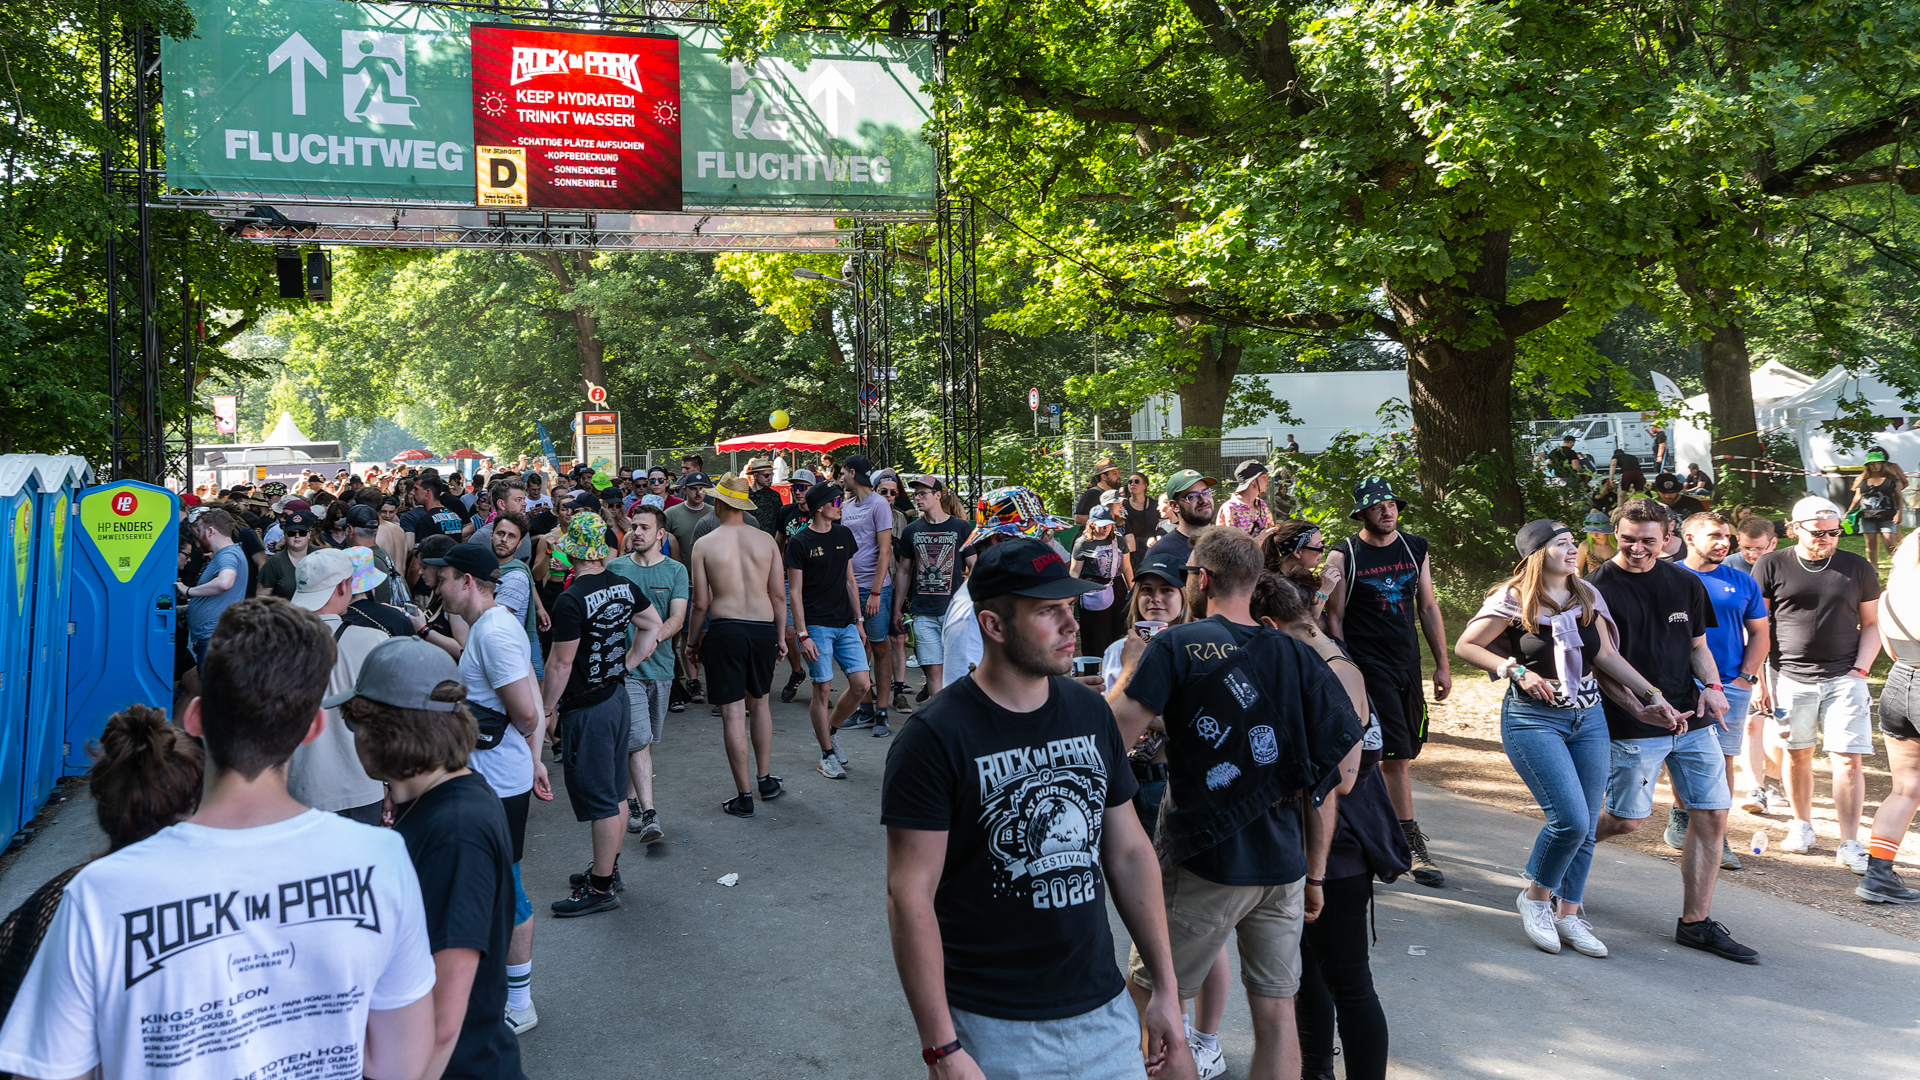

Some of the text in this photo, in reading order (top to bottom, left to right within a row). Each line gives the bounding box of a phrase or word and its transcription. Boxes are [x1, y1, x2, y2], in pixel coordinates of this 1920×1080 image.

[511, 47, 643, 93] ROCK IM PARK
[516, 89, 635, 108] KEEP HYDRATED!
[516, 109, 635, 127] TRINKT WASSER!
[225, 129, 463, 171] FLUCHTWEG
[518, 137, 645, 150] SCHATTIGE PLÄTZE AUFSUCHEN
[490, 158, 518, 188] D
[554, 165, 617, 175] SONNENCREME
[697, 151, 891, 183] FLUCHTWEG
[554, 179, 618, 188] SONNENBRILLE
[1050, 405, 1058, 414] P
[97, 521, 153, 533] HP ENDERS
[97, 533, 153, 541] UMWELTSERVICE
[916, 535, 953, 544] ROCK RING
[1356, 562, 1416, 577] RAMMSTEIN
[584, 589, 610, 619] ROCK
[974, 734, 1107, 806] ROCK IM PARK
[1016, 785, 1095, 852] LIVE AT NUREMBERG
[1001, 829, 1013, 842] 19
[1035, 854, 1088, 872] FESTIVAL
[1031, 870, 1096, 909] 2022
[120, 864, 382, 990] ROCK IM PARK
[232, 955, 251, 965] JUNE
[141, 985, 269, 1025] KINGS OF LEON
[202, 1016, 239, 1031] INCUBUS
[303, 993, 331, 1003] ROACH
[169, 1011, 225, 1032] TENACIOUS
[226, 1008, 234, 1018] D
[260, 1050, 312, 1075] TOTEN
[282, 1057, 326, 1075] MACHINE
[328, 1055, 348, 1064] GUN
